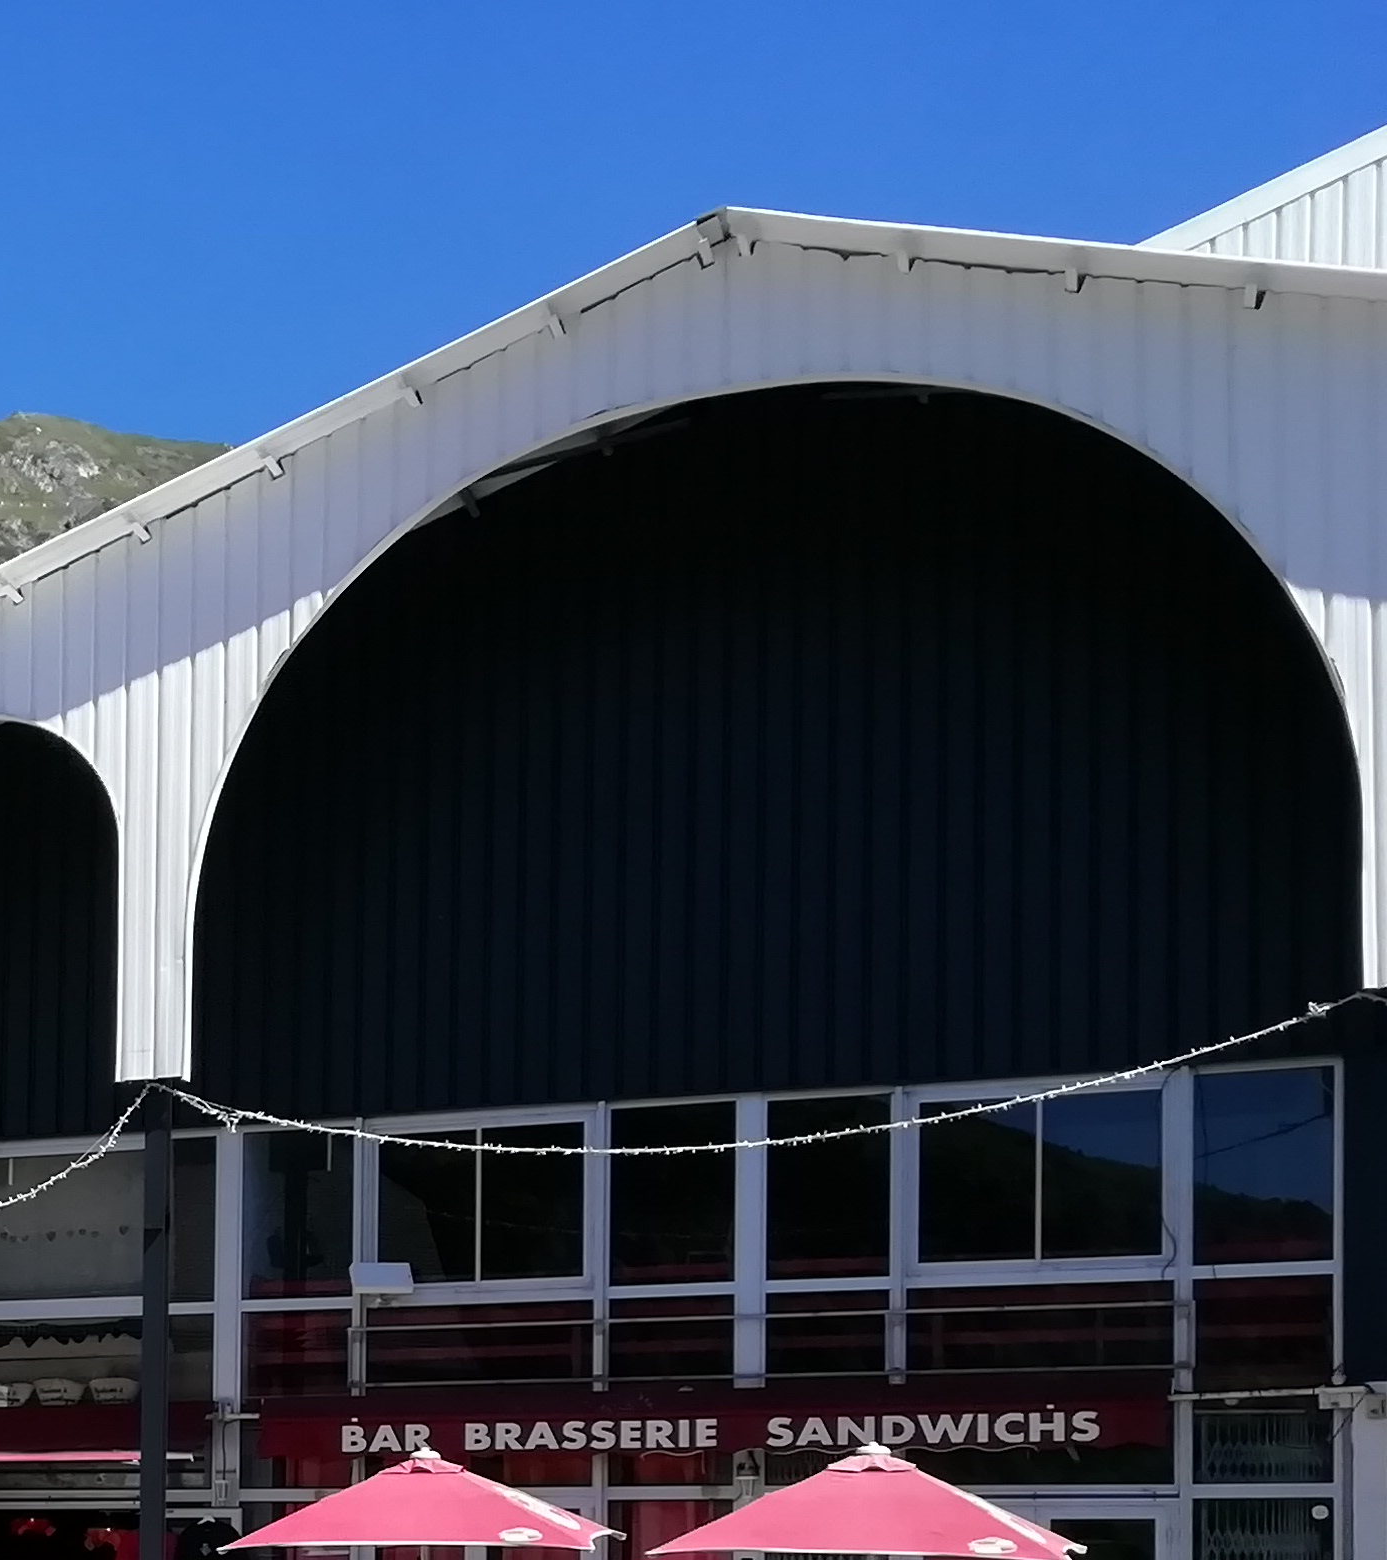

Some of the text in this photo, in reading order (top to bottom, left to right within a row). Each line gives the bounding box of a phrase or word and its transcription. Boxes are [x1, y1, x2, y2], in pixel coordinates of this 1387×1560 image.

[341, 1411, 1101, 1453] BAR BRASSERIE SANDWICHS
